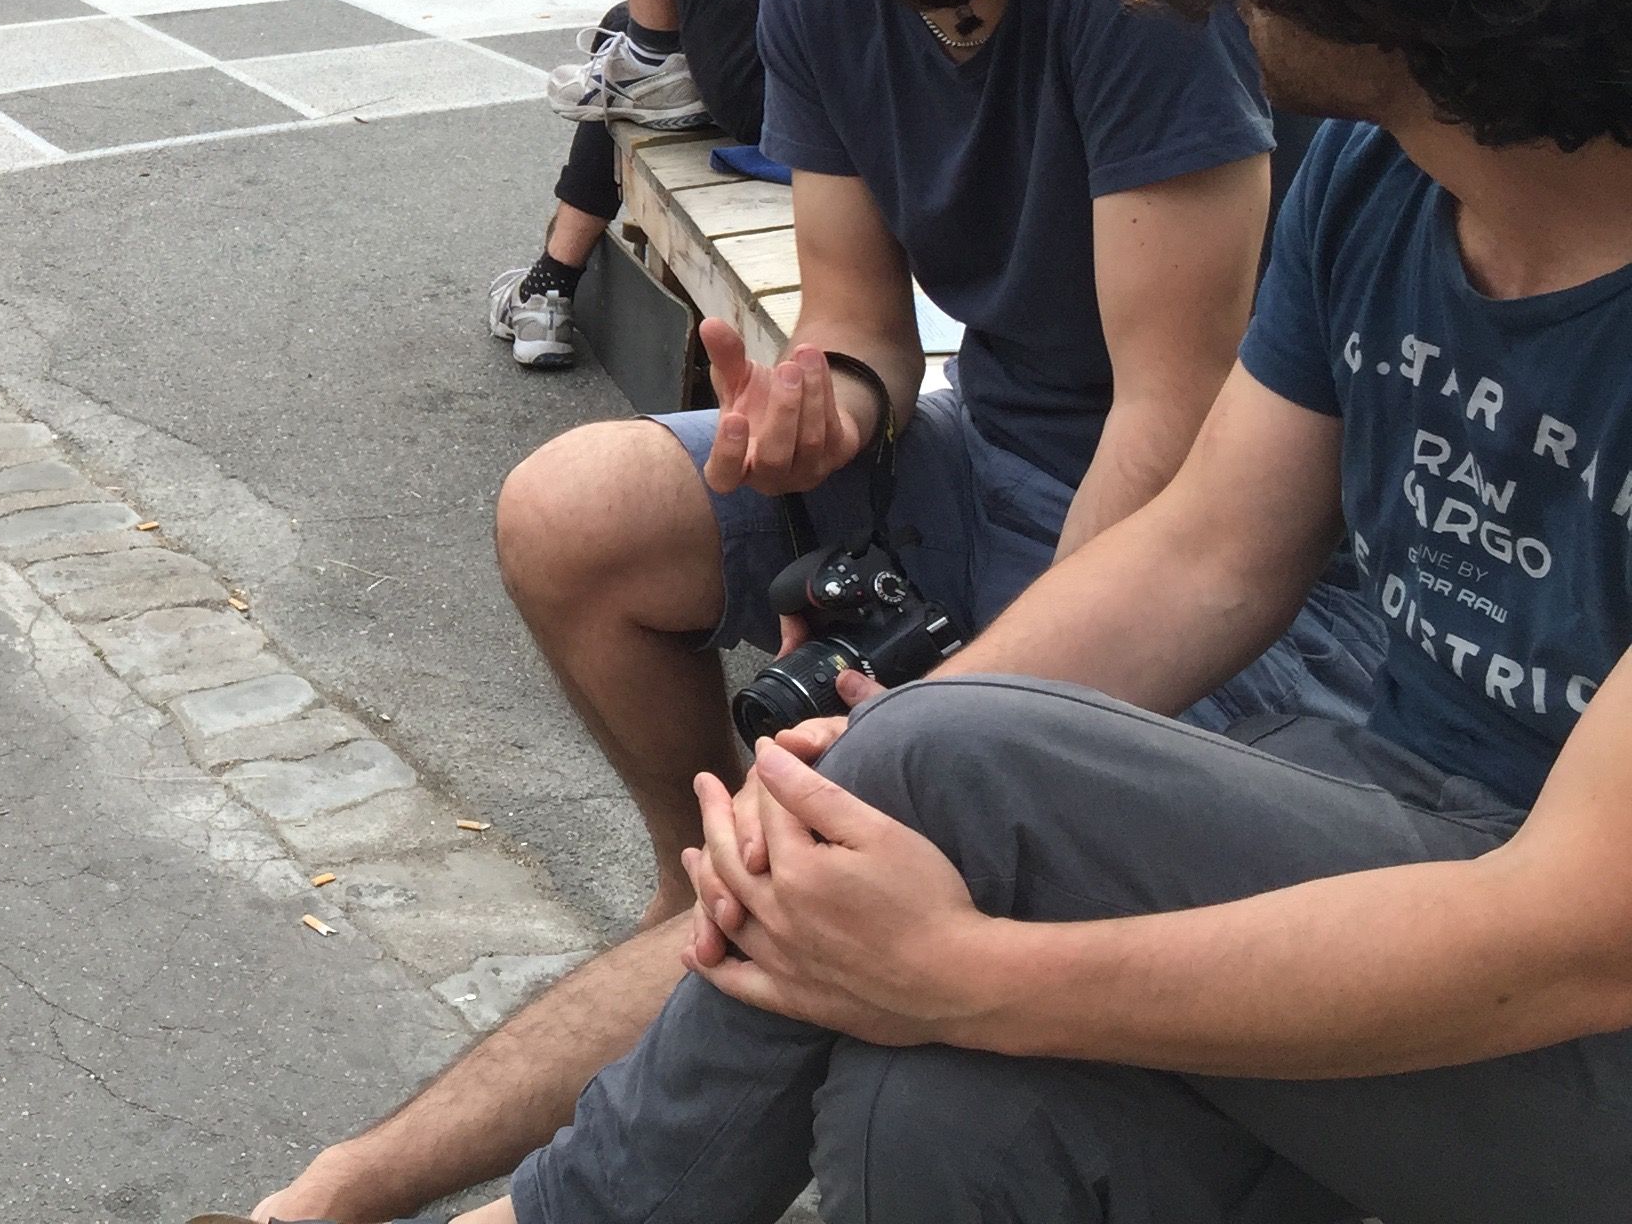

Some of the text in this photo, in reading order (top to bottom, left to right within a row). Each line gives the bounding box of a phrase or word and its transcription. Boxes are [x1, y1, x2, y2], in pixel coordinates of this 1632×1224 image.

[1413, 429, 1517, 514] RAW
[1457, 561, 1489, 583] BY
[1456, 588, 1508, 624] RAW
